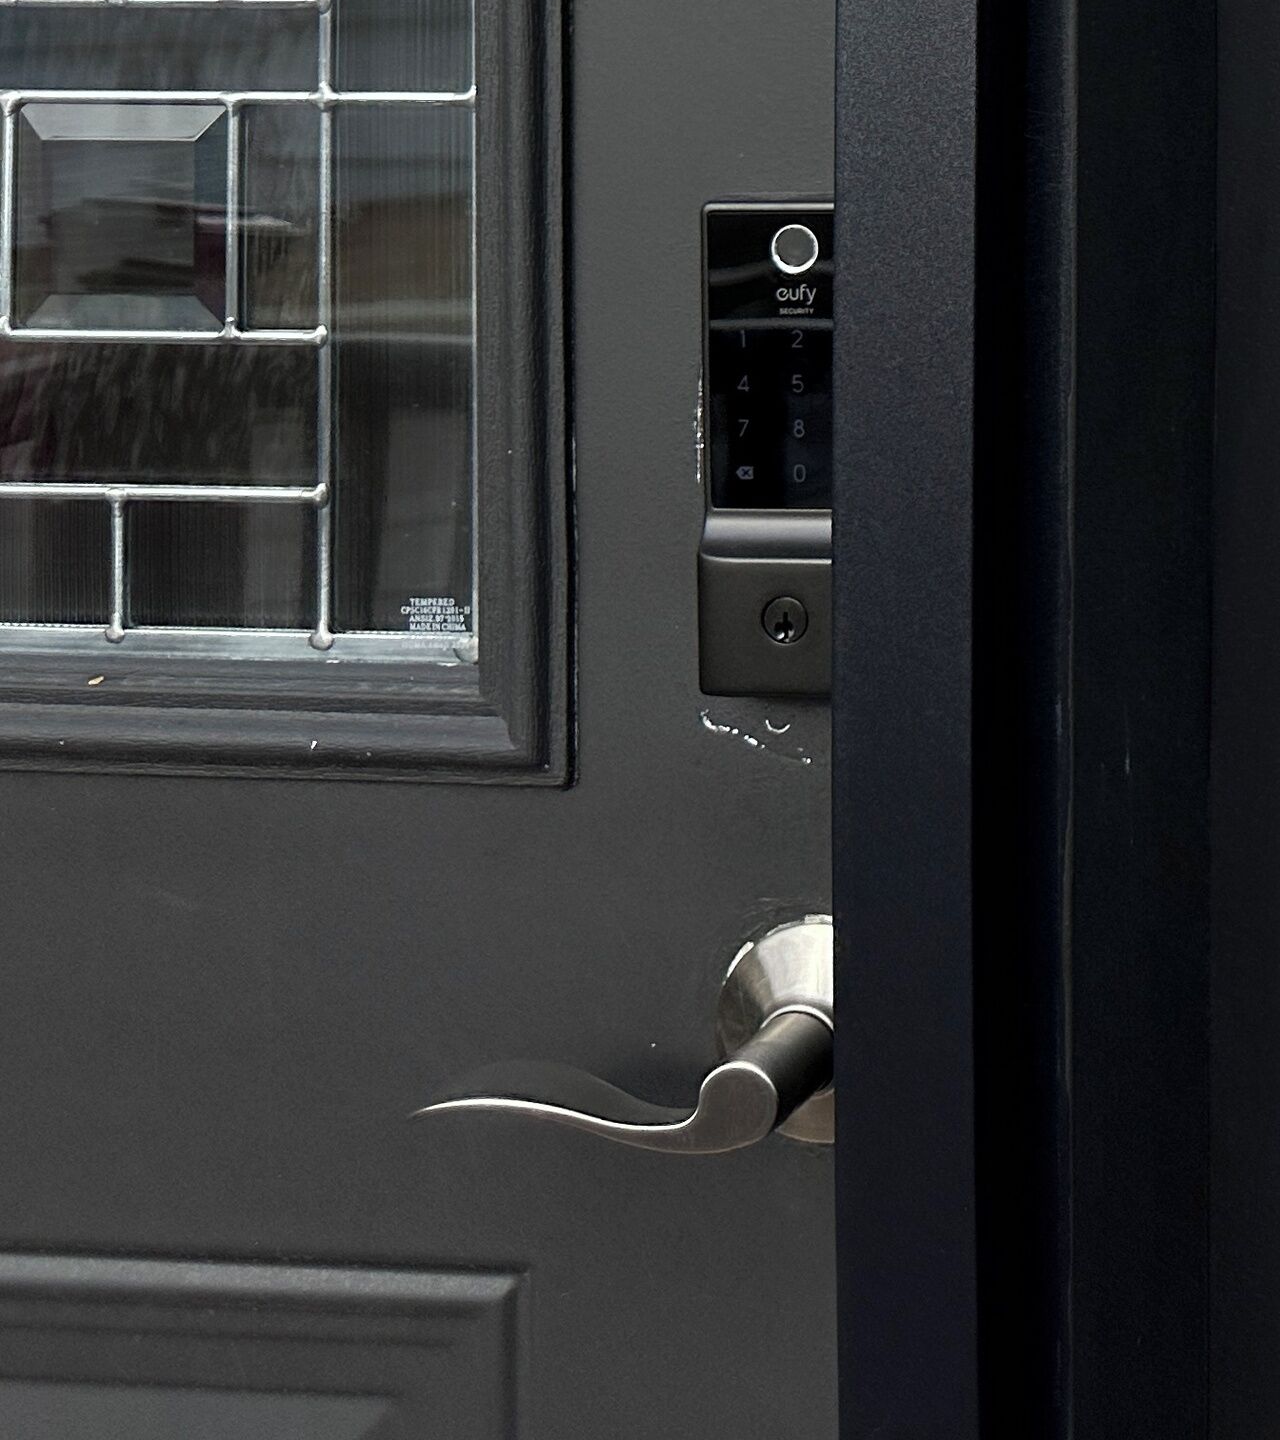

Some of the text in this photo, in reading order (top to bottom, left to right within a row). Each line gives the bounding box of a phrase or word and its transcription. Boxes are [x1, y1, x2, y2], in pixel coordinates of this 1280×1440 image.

[775, 283, 817, 305] eufy
[779, 307, 815, 315] SECURITY
[739, 329, 804, 348] 1 2
[737, 374, 804, 393] 4 5
[737, 419, 805, 438] 7 8
[793, 463, 806, 482] 0
